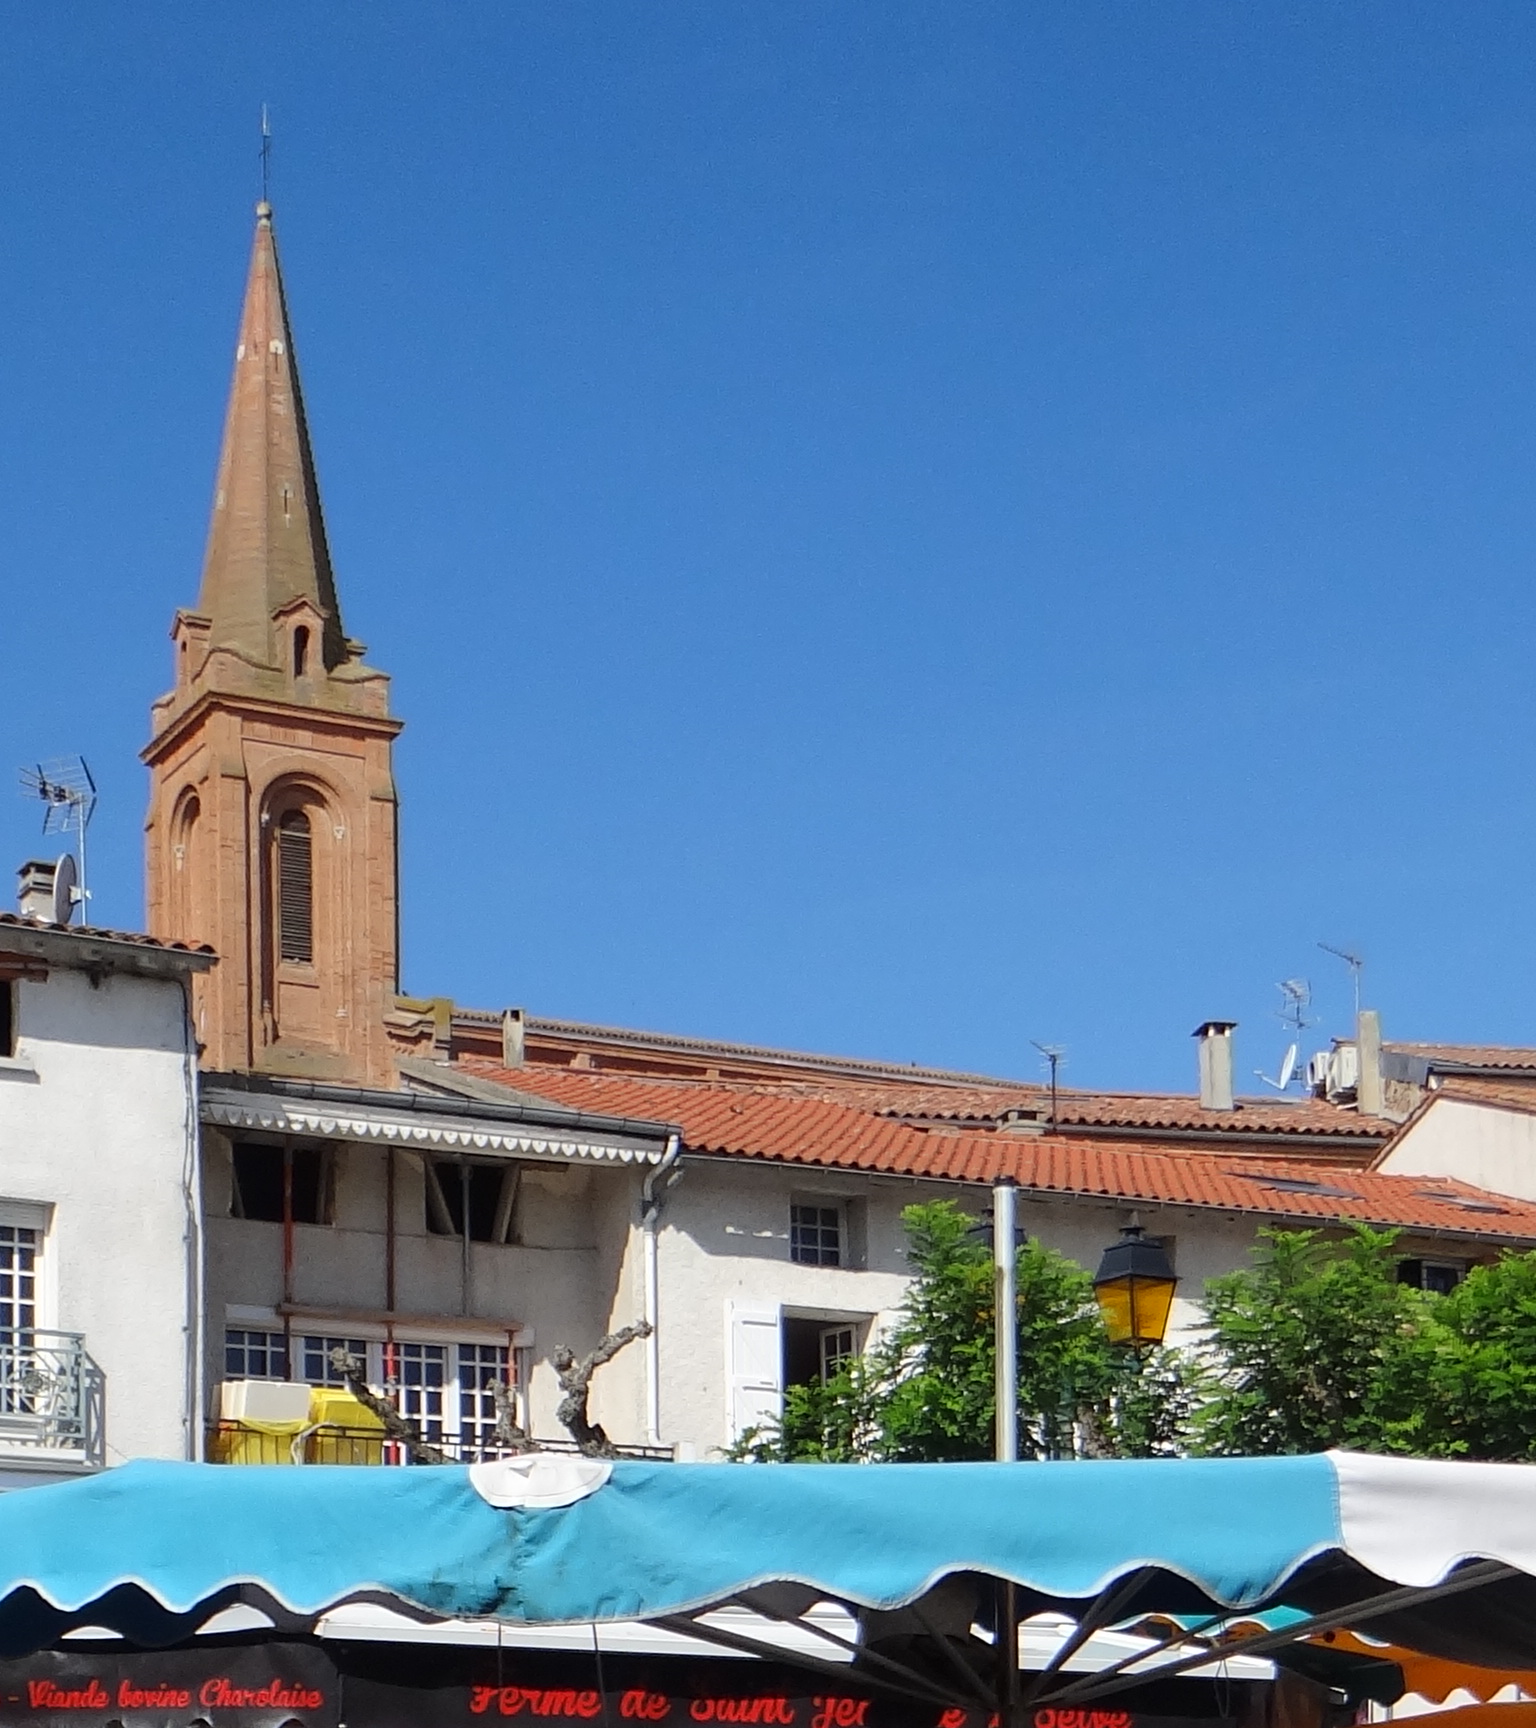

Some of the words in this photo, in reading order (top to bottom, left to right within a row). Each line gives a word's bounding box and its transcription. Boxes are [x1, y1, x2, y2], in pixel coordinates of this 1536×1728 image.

[28, 1680, 109, 1709] Viande
[117, 1679, 190, 1708] bovine
[199, 1677, 323, 1709] Charolaise
